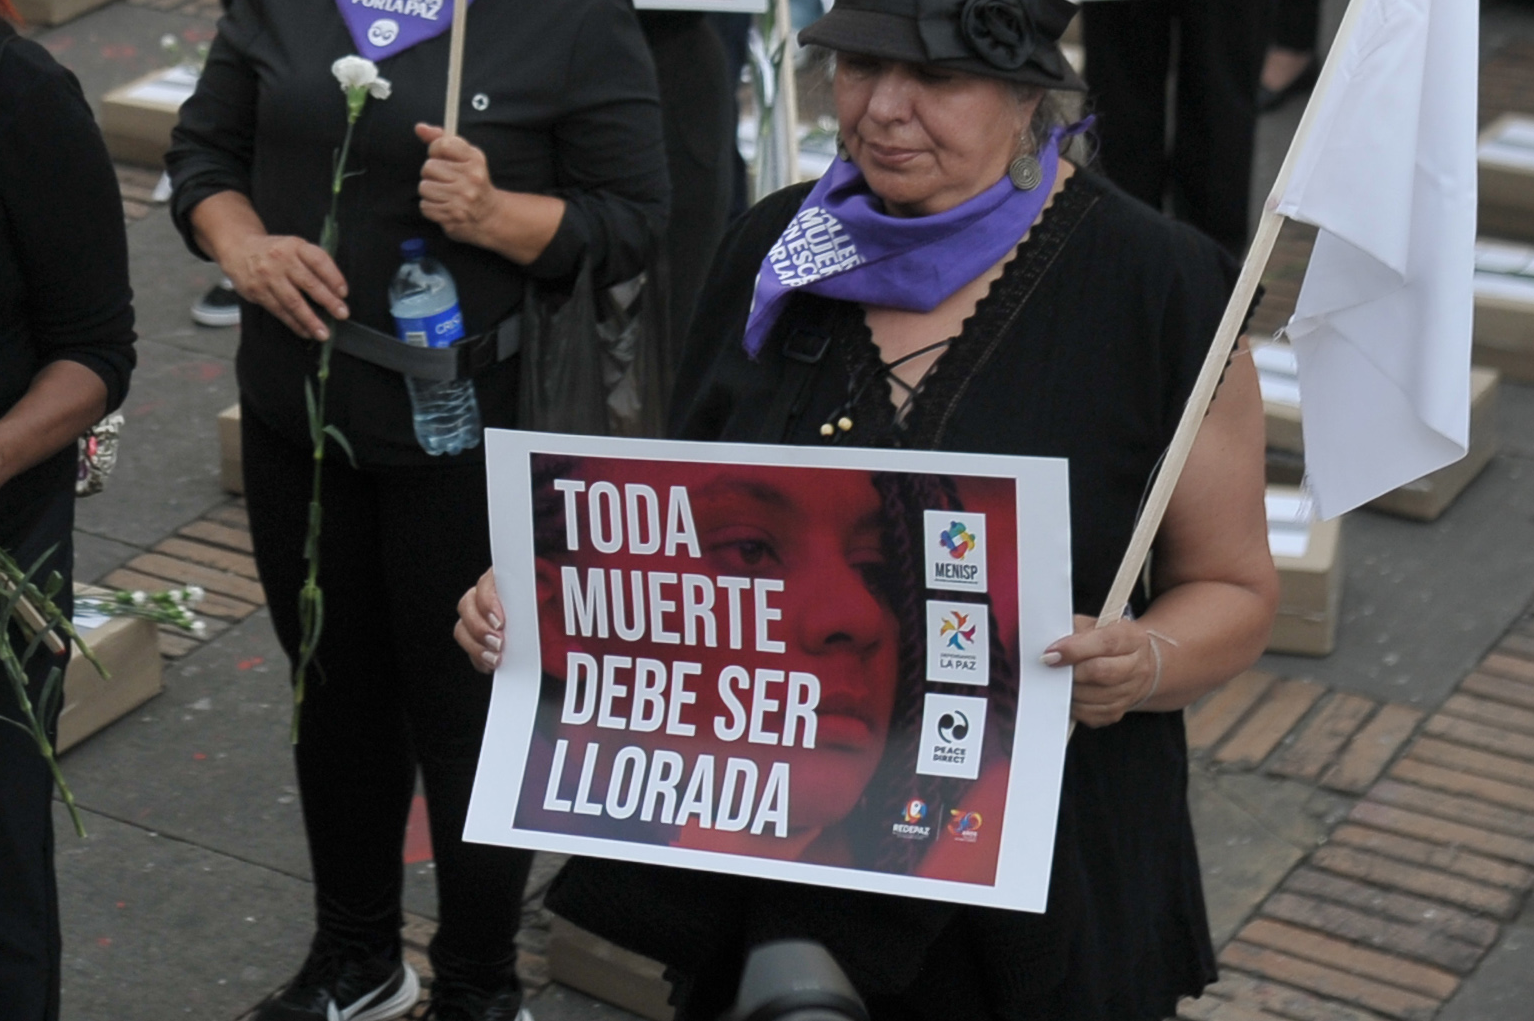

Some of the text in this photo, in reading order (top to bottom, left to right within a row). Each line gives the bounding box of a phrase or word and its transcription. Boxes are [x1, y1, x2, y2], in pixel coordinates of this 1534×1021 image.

[554, 479, 701, 558] TODA
[935, 562, 978, 580] MENISP
[561, 566, 786, 653] MUERTE
[940, 659, 977, 671] LA PAZ
[561, 652, 821, 749] DEBE SER
[933, 754, 965, 764] DIRECT
[934, 746, 966, 756] PEACE
[542, 739, 790, 838] LLORADA
[892, 823, 931, 836] REDEPAZ
